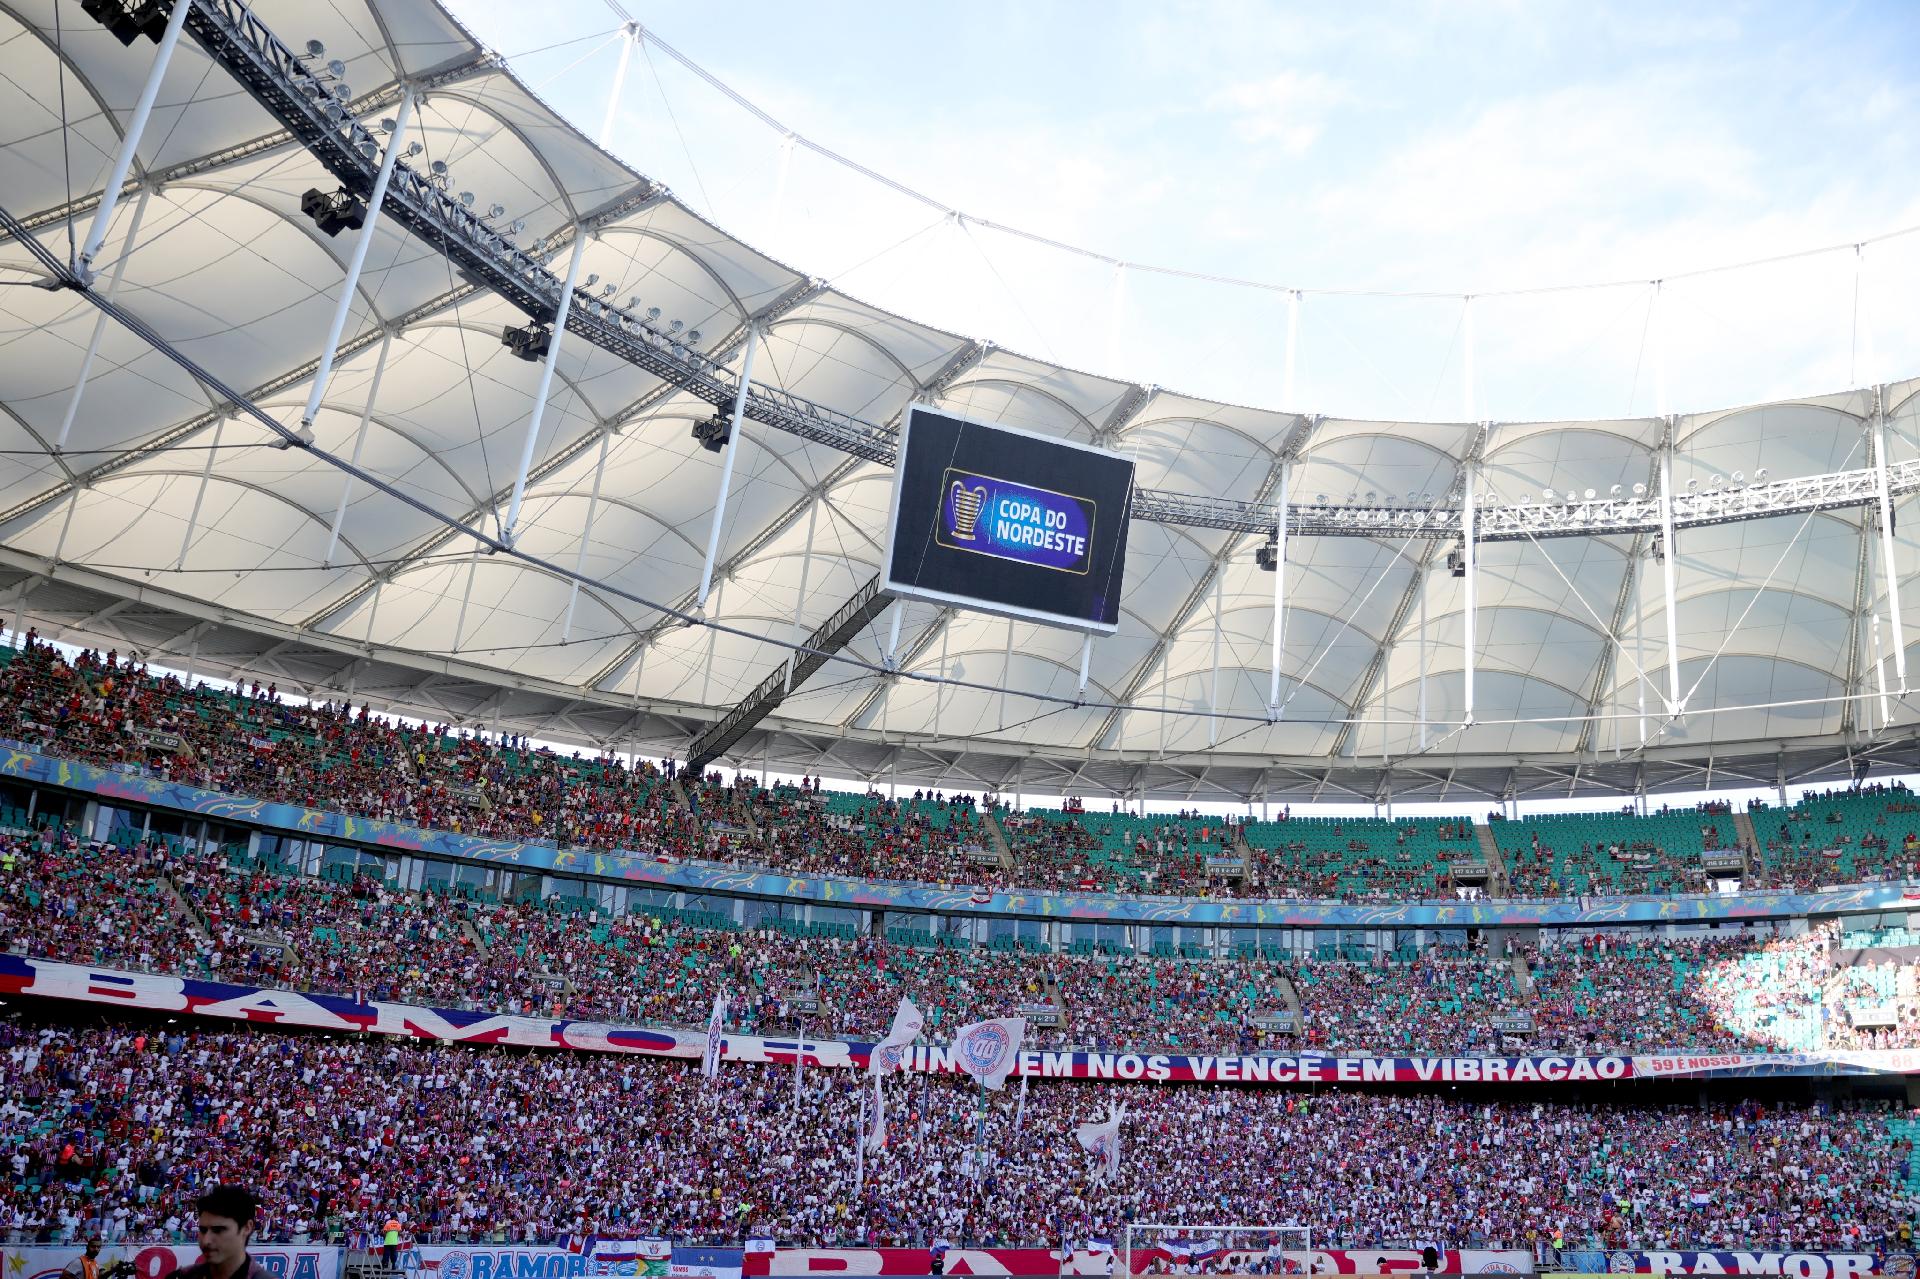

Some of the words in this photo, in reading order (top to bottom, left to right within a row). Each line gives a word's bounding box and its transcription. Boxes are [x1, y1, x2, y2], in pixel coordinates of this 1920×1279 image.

[1000, 500, 1040, 525] COPA
[1045, 509, 1067, 530] DO
[997, 519, 1085, 556] NORDESTE
[266, 947, 282, 956] 222
[550, 980, 563, 989] 221
[1280, 1022, 1291, 1030] 217
[1088, 1054, 1171, 1080] NOS
[1186, 1056, 1322, 1082] VENCE
[1337, 1057, 1396, 1082] EM
[1651, 1058, 1674, 1072] 59
[1677, 1056, 1685, 1070] É
[1690, 1055, 1742, 1069] NOSSO
[469, 1253, 589, 1278] BAMOR
[1643, 1252, 1874, 1279] BAMOR
